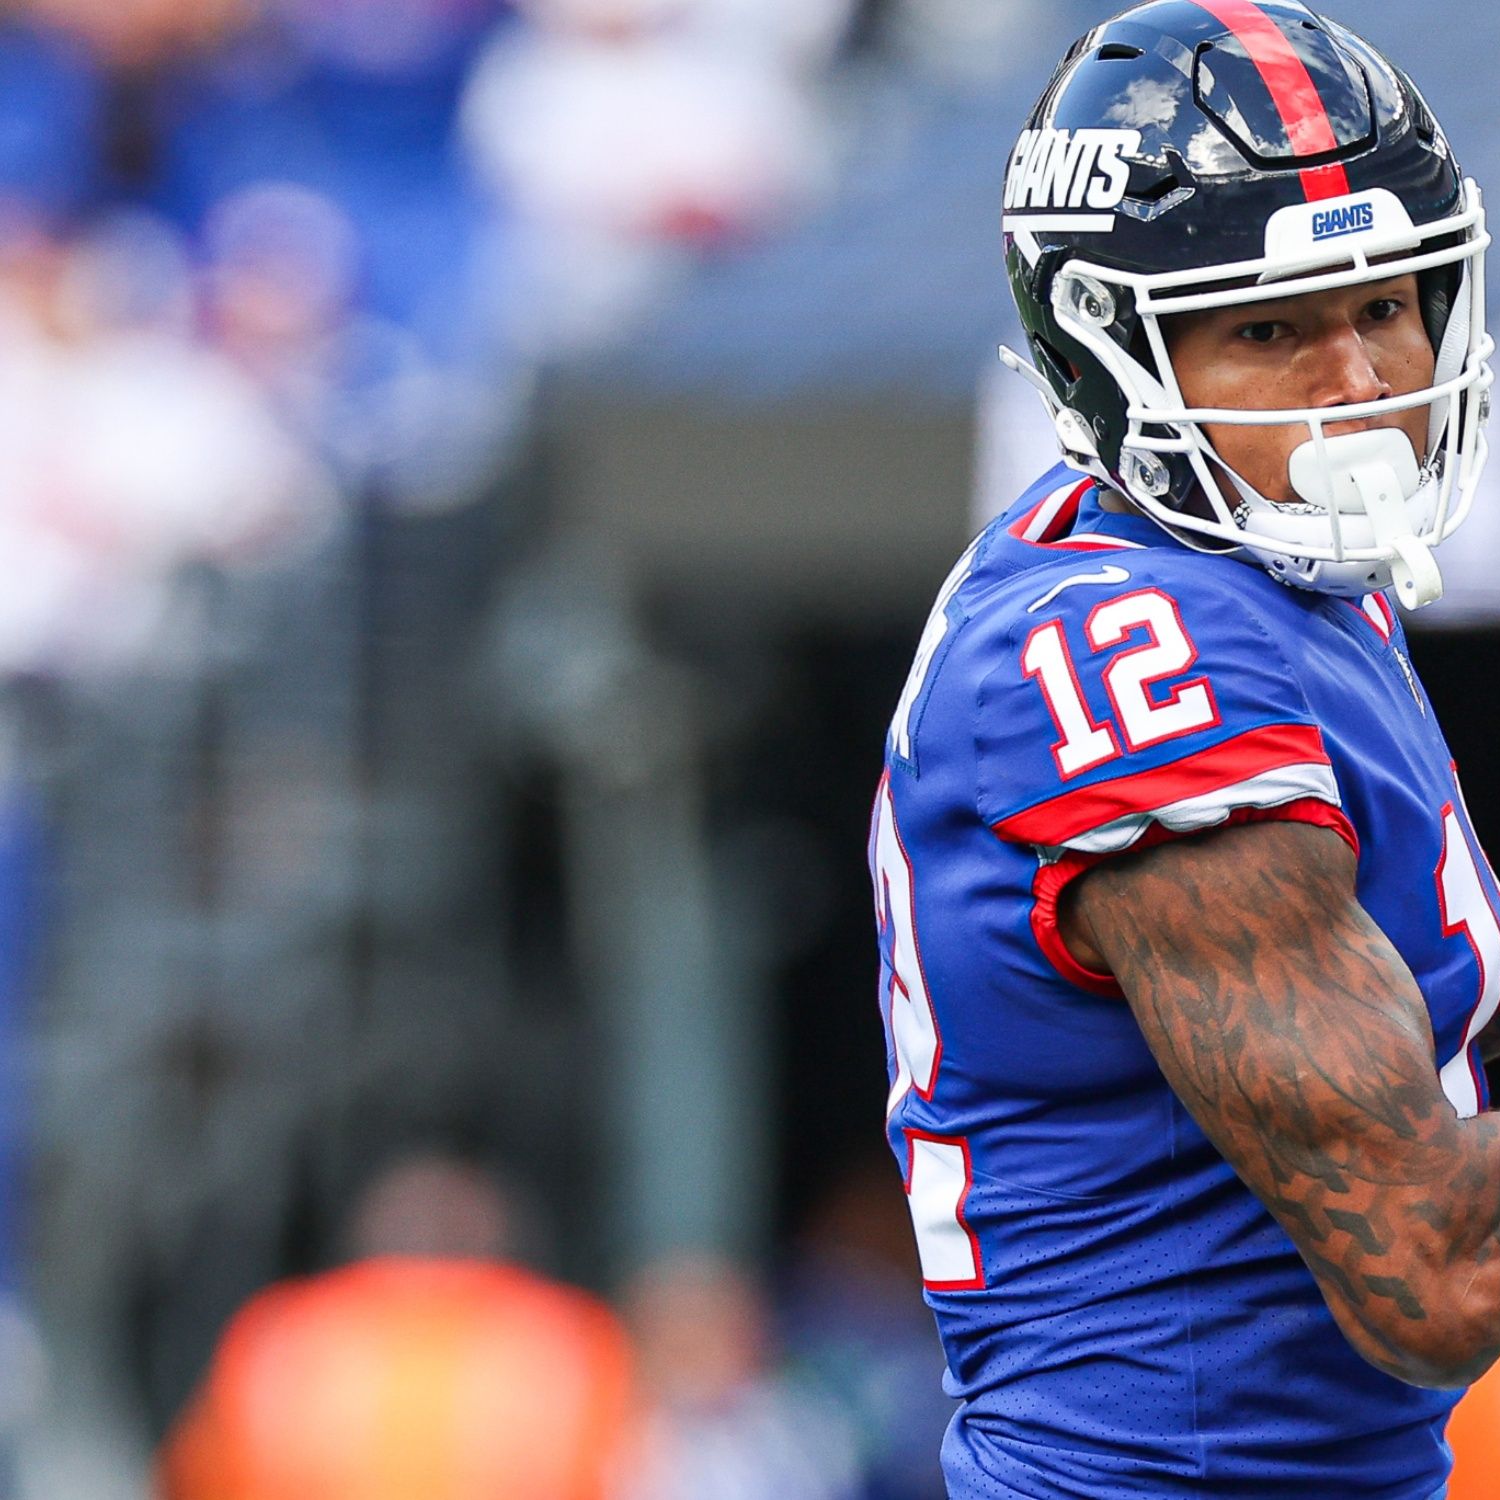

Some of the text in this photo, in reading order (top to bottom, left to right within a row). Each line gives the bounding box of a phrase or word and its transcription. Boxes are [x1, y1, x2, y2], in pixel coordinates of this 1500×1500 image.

[1004, 129, 1141, 209] GIANTS
[1312, 202, 1373, 235] GIANTS
[1020, 586, 1223, 782] 12
